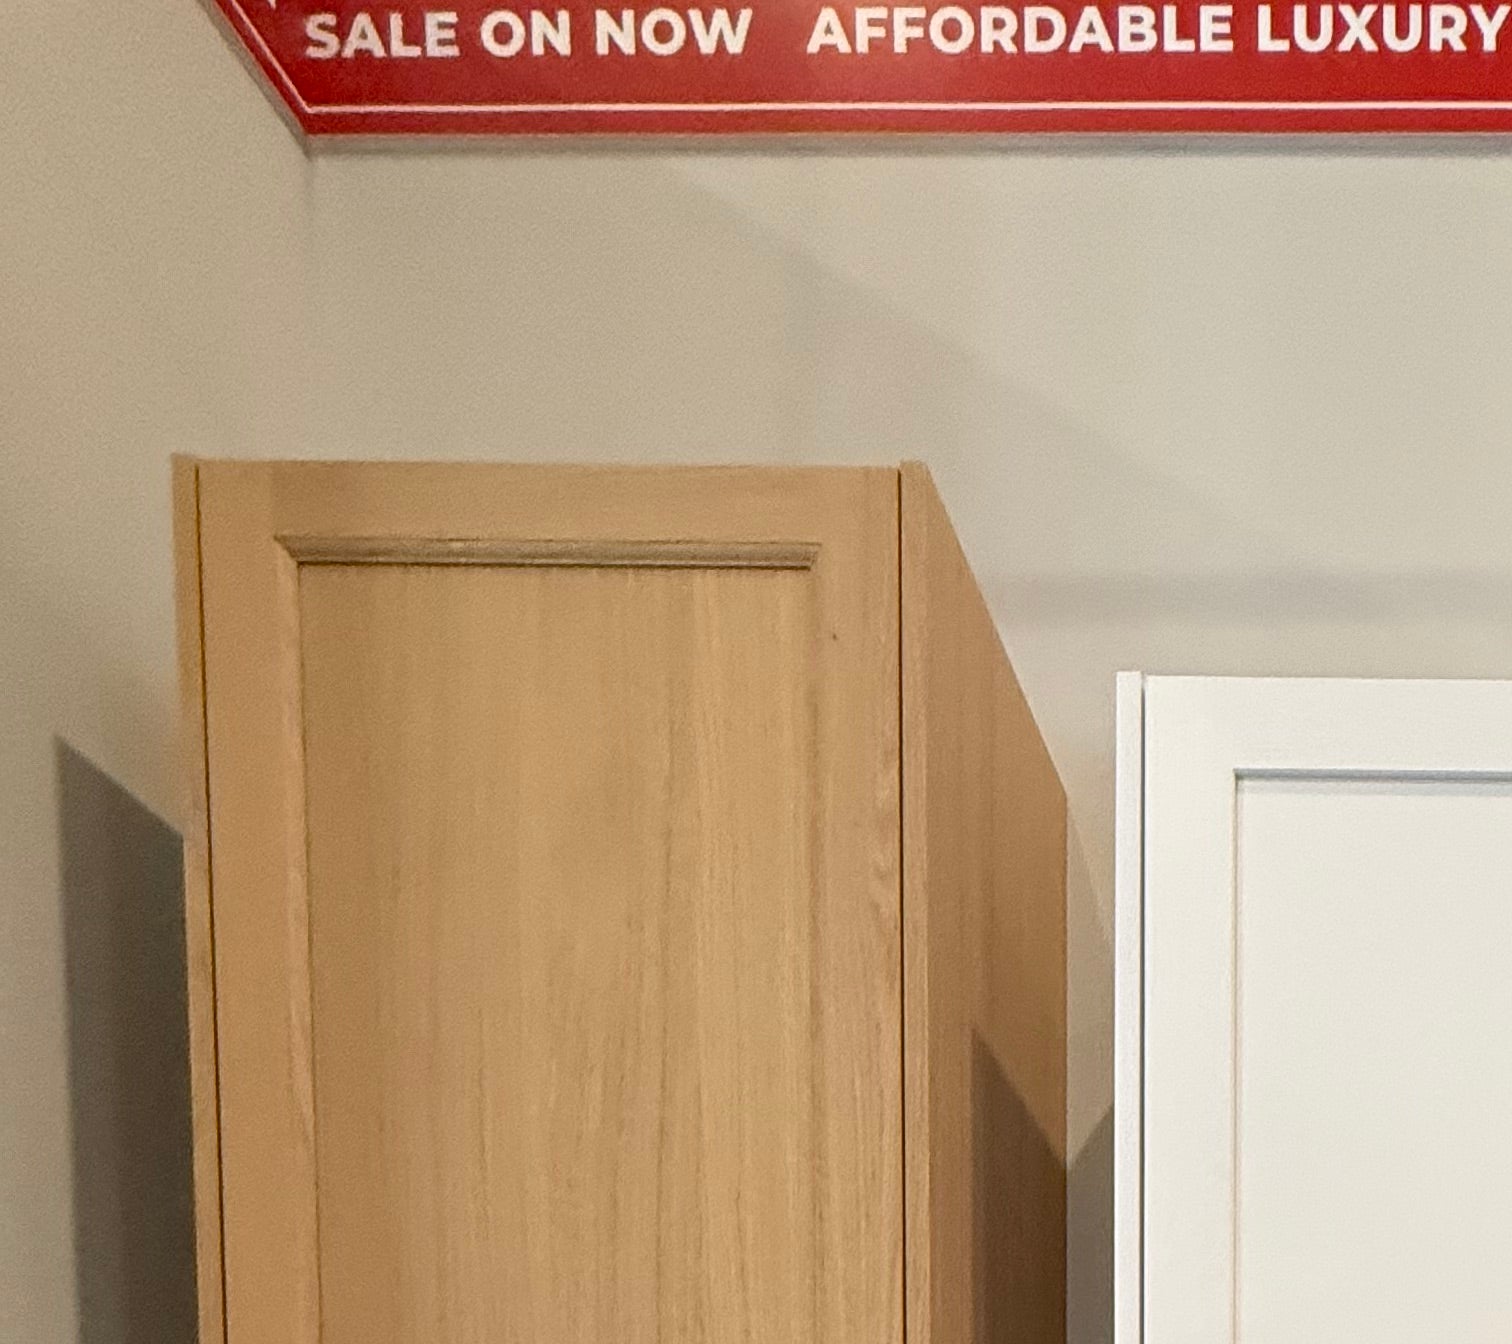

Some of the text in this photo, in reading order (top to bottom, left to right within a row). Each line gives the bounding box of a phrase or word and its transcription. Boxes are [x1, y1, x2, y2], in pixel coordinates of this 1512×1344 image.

[304, 8, 753, 59] SALE ON NOW
[805, 4, 1512, 54] AFFORDABLE LUXURY
